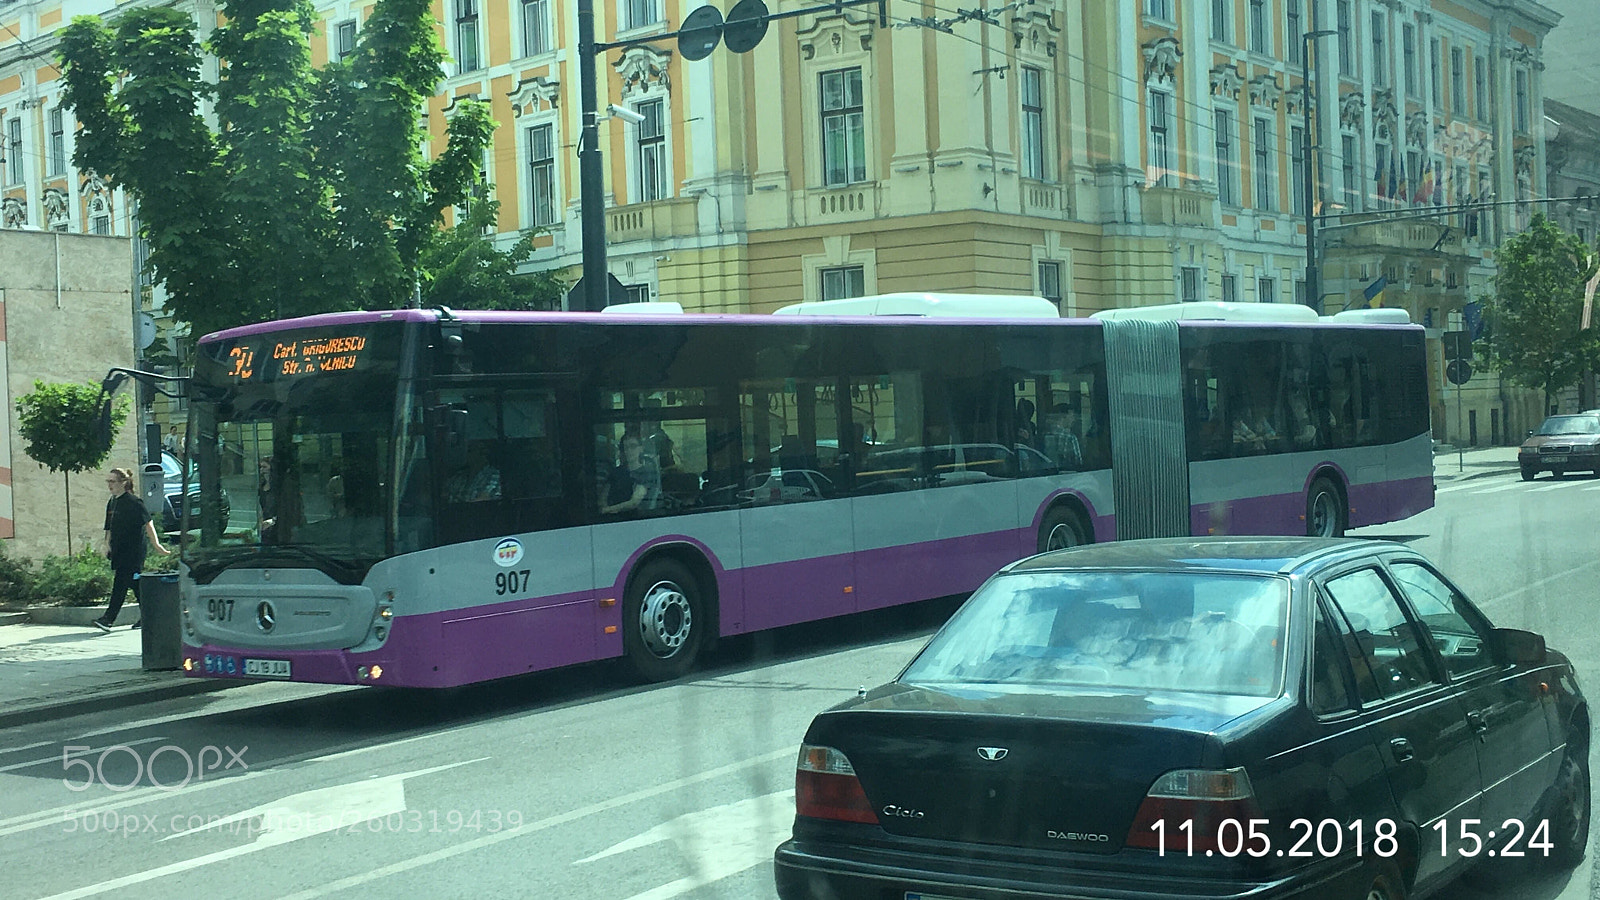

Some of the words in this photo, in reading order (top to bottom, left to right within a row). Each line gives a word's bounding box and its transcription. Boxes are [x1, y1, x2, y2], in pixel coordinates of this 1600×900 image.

[282, 360, 302, 375] Str.
[495, 569, 531, 596] 907
[207, 598, 235, 622] 907
[1047, 830, 1109, 842] DAEWOO
